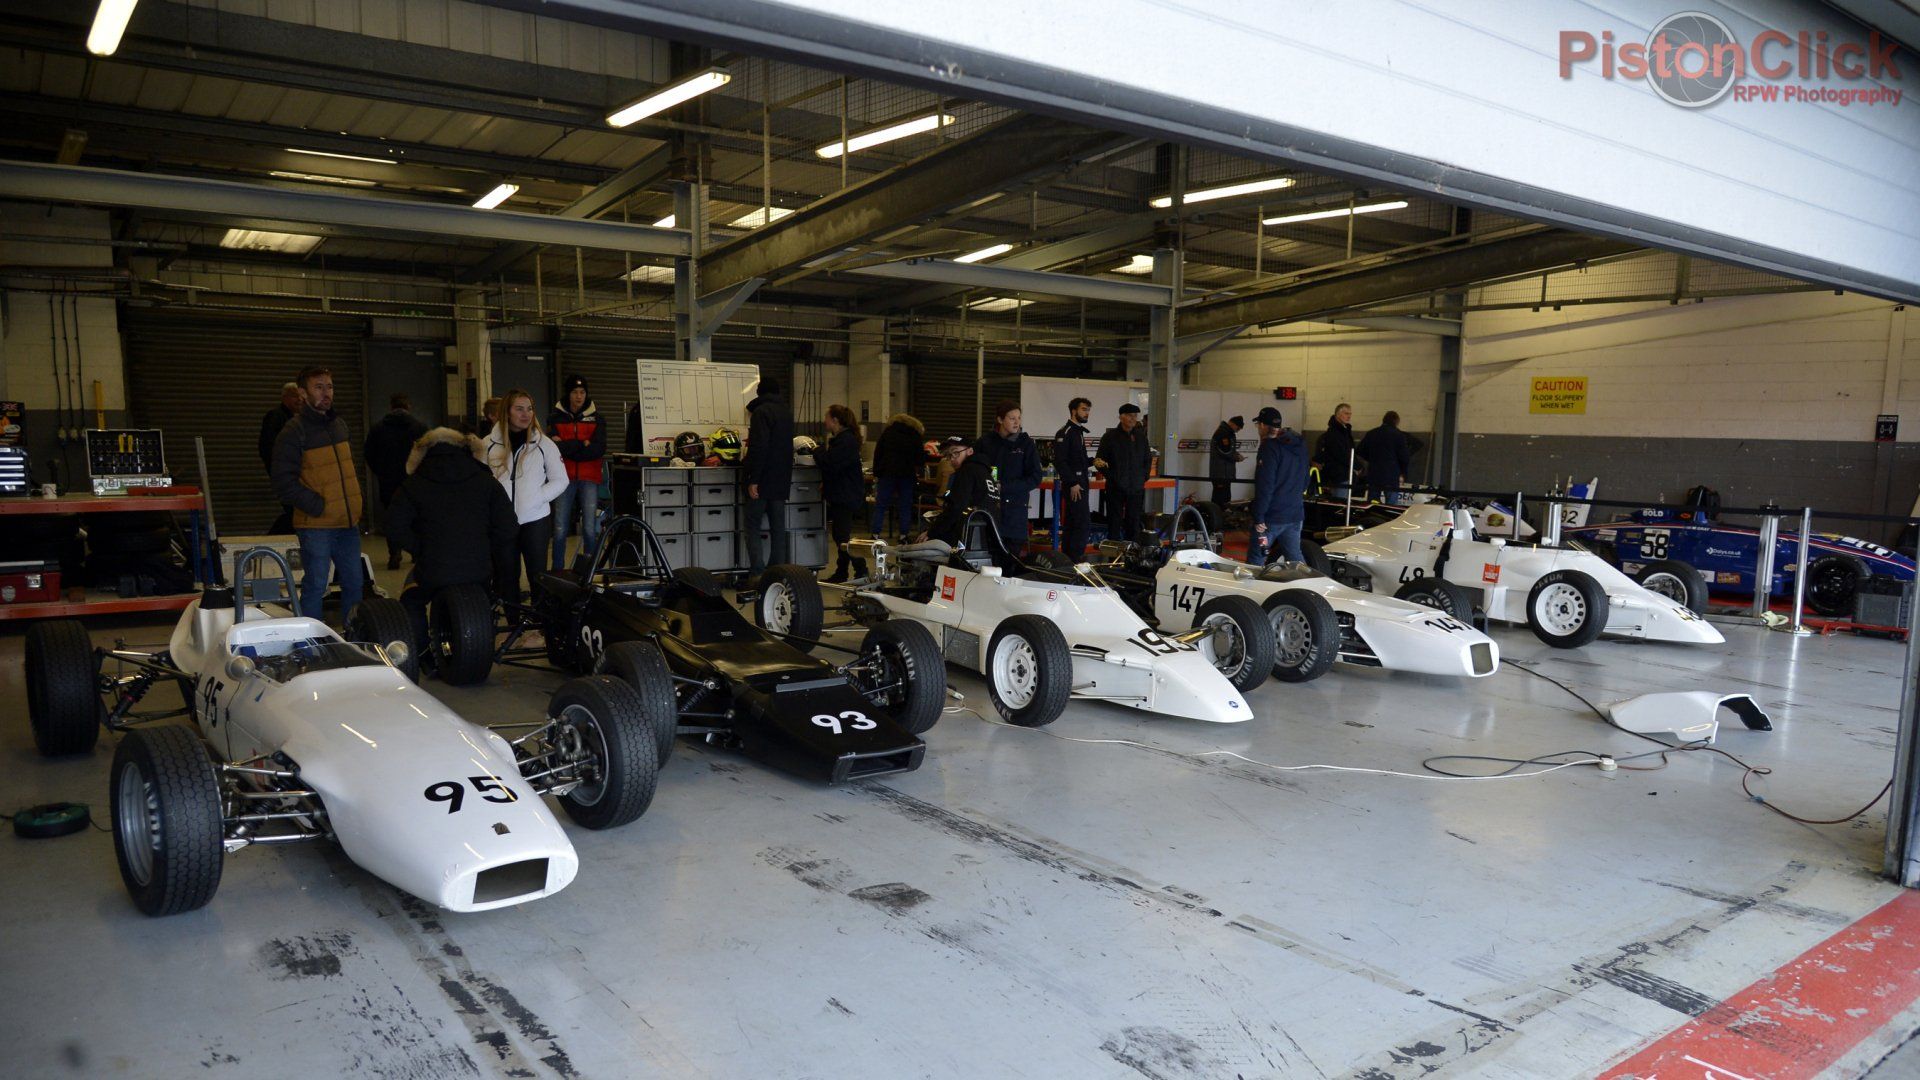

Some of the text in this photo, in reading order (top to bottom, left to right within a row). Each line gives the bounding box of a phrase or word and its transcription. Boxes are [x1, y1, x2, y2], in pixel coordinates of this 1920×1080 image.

[1534, 381, 1584, 391] CAUTION
[1554, 394, 1585, 402] SLIPPERY
[1641, 533, 1669, 559] 58
[1169, 584, 1205, 612] 147
[204, 676, 224, 728] 95
[811, 710, 878, 735] 93
[424, 776, 519, 814] 95
